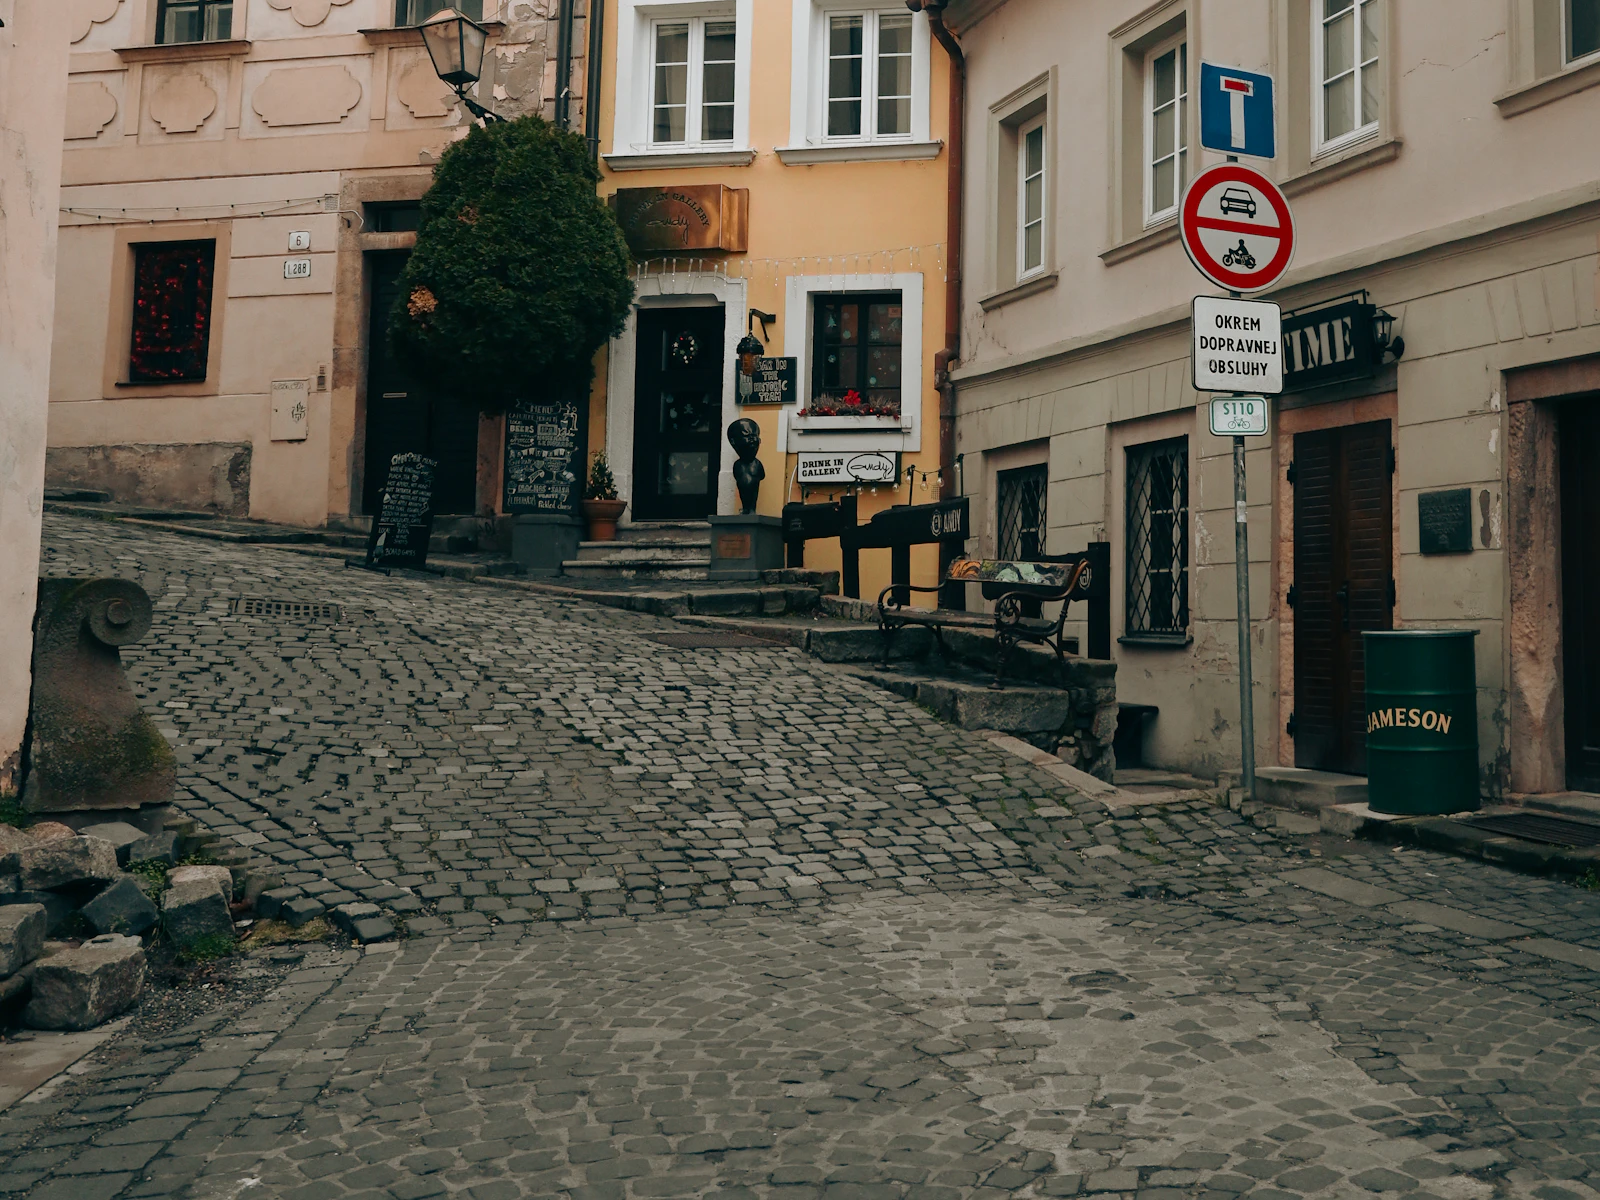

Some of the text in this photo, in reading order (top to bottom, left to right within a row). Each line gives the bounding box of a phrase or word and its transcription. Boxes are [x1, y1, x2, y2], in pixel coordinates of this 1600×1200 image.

[656, 193, 669, 203] IN
[672, 193, 710, 226] GALLERY
[296, 235, 302, 246] 6
[1215, 314, 1261, 331] OKREM
[1200, 336, 1276, 355] DOPRAVNEJ
[775, 359, 788, 371] IN
[1209, 359, 1268, 376] OBSLUHY
[762, 371, 779, 381] THE
[754, 380, 788, 392] HISTORIC
[758, 392, 782, 402] TRAM
[530, 405, 553, 414] MENU
[1224, 402, 1254, 415] S110
[510, 425, 534, 434] BEERS
[802, 458, 844, 468] DRINK IN
[802, 467, 841, 477] GALLERY
[943, 508, 961, 533] ANDY
[385, 548, 401, 556] BOARD
[1367, 708, 1452, 734] JAMESON
